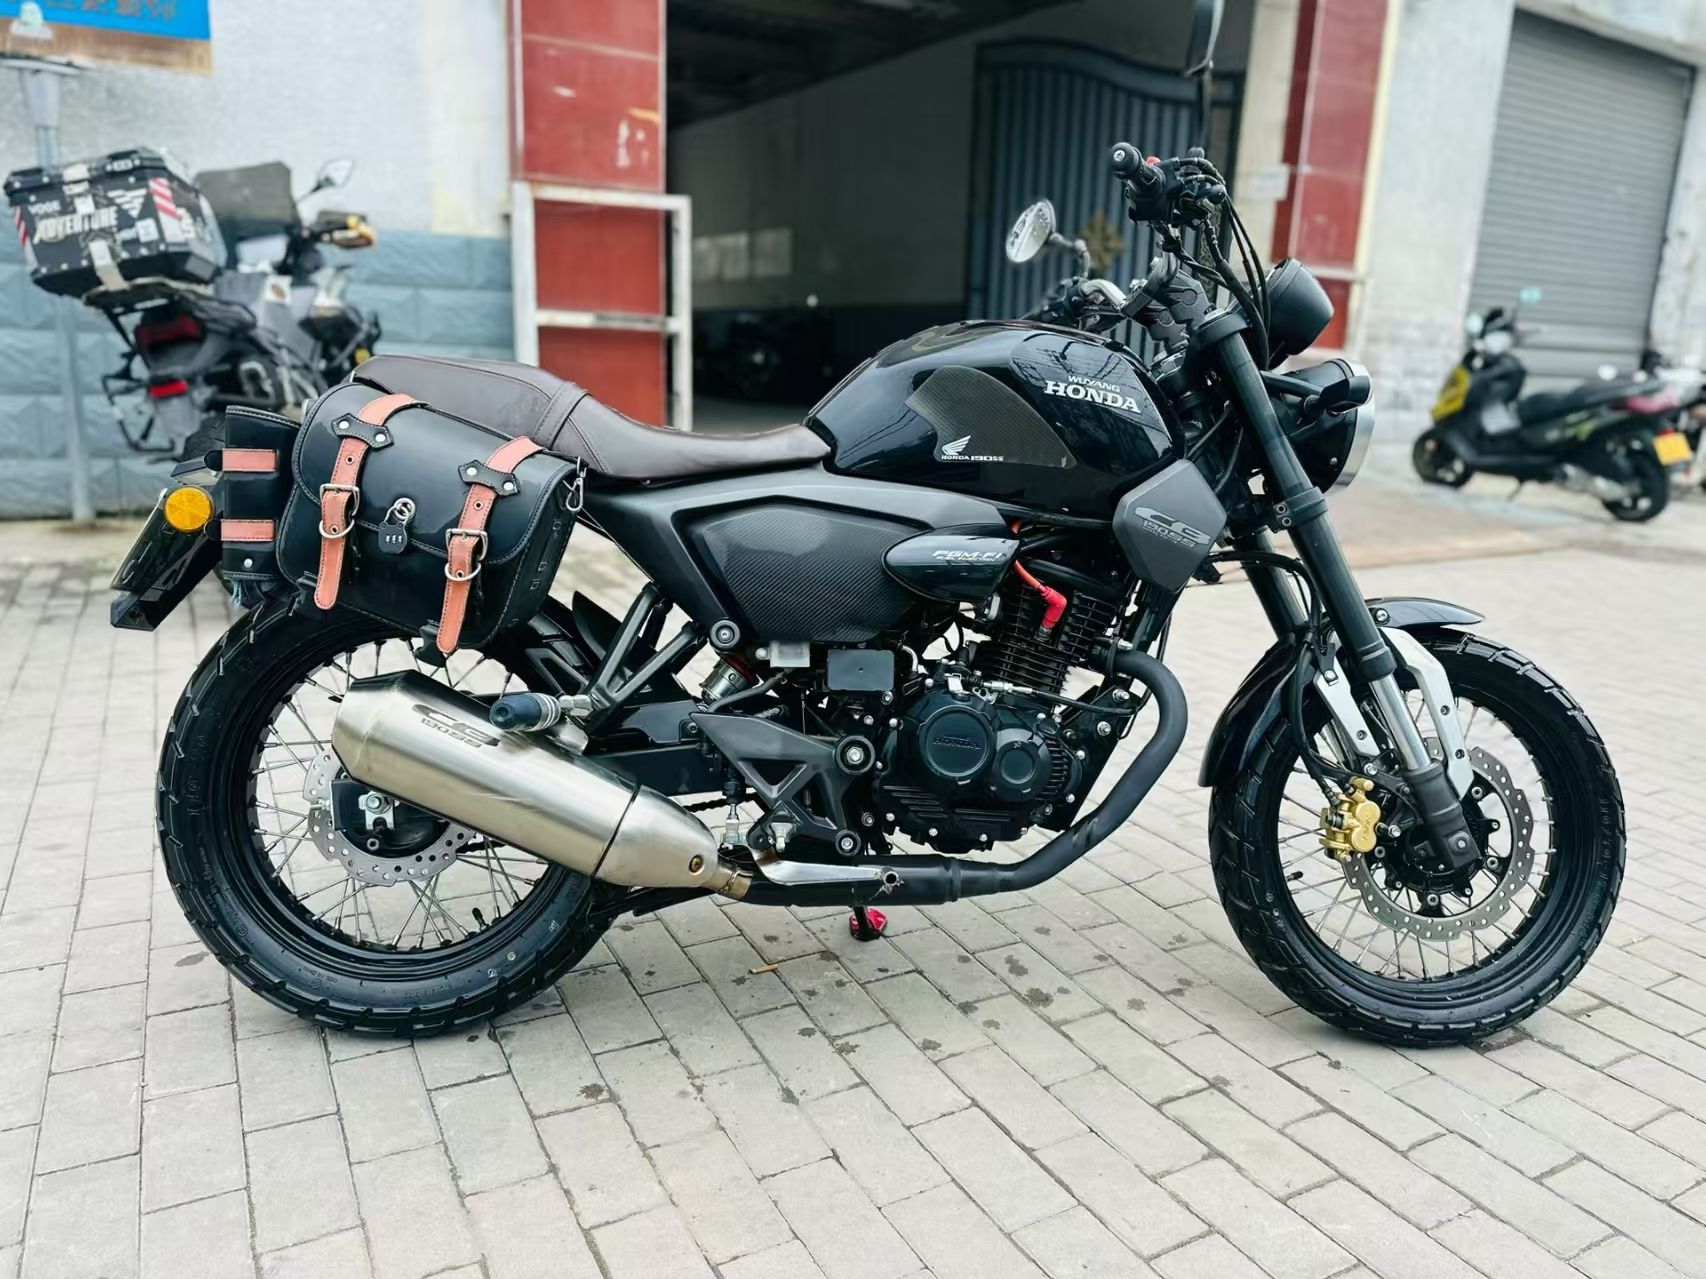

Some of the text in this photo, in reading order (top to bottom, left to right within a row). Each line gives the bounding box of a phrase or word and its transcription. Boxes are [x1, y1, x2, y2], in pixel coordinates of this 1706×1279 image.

[34, 206, 118, 244] ADVENTURE
[1044, 380, 1142, 413] HONDA
[1068, 375, 1120, 392] WUYANG
[1134, 507, 1211, 546] CB
[412, 703, 500, 747] CB
